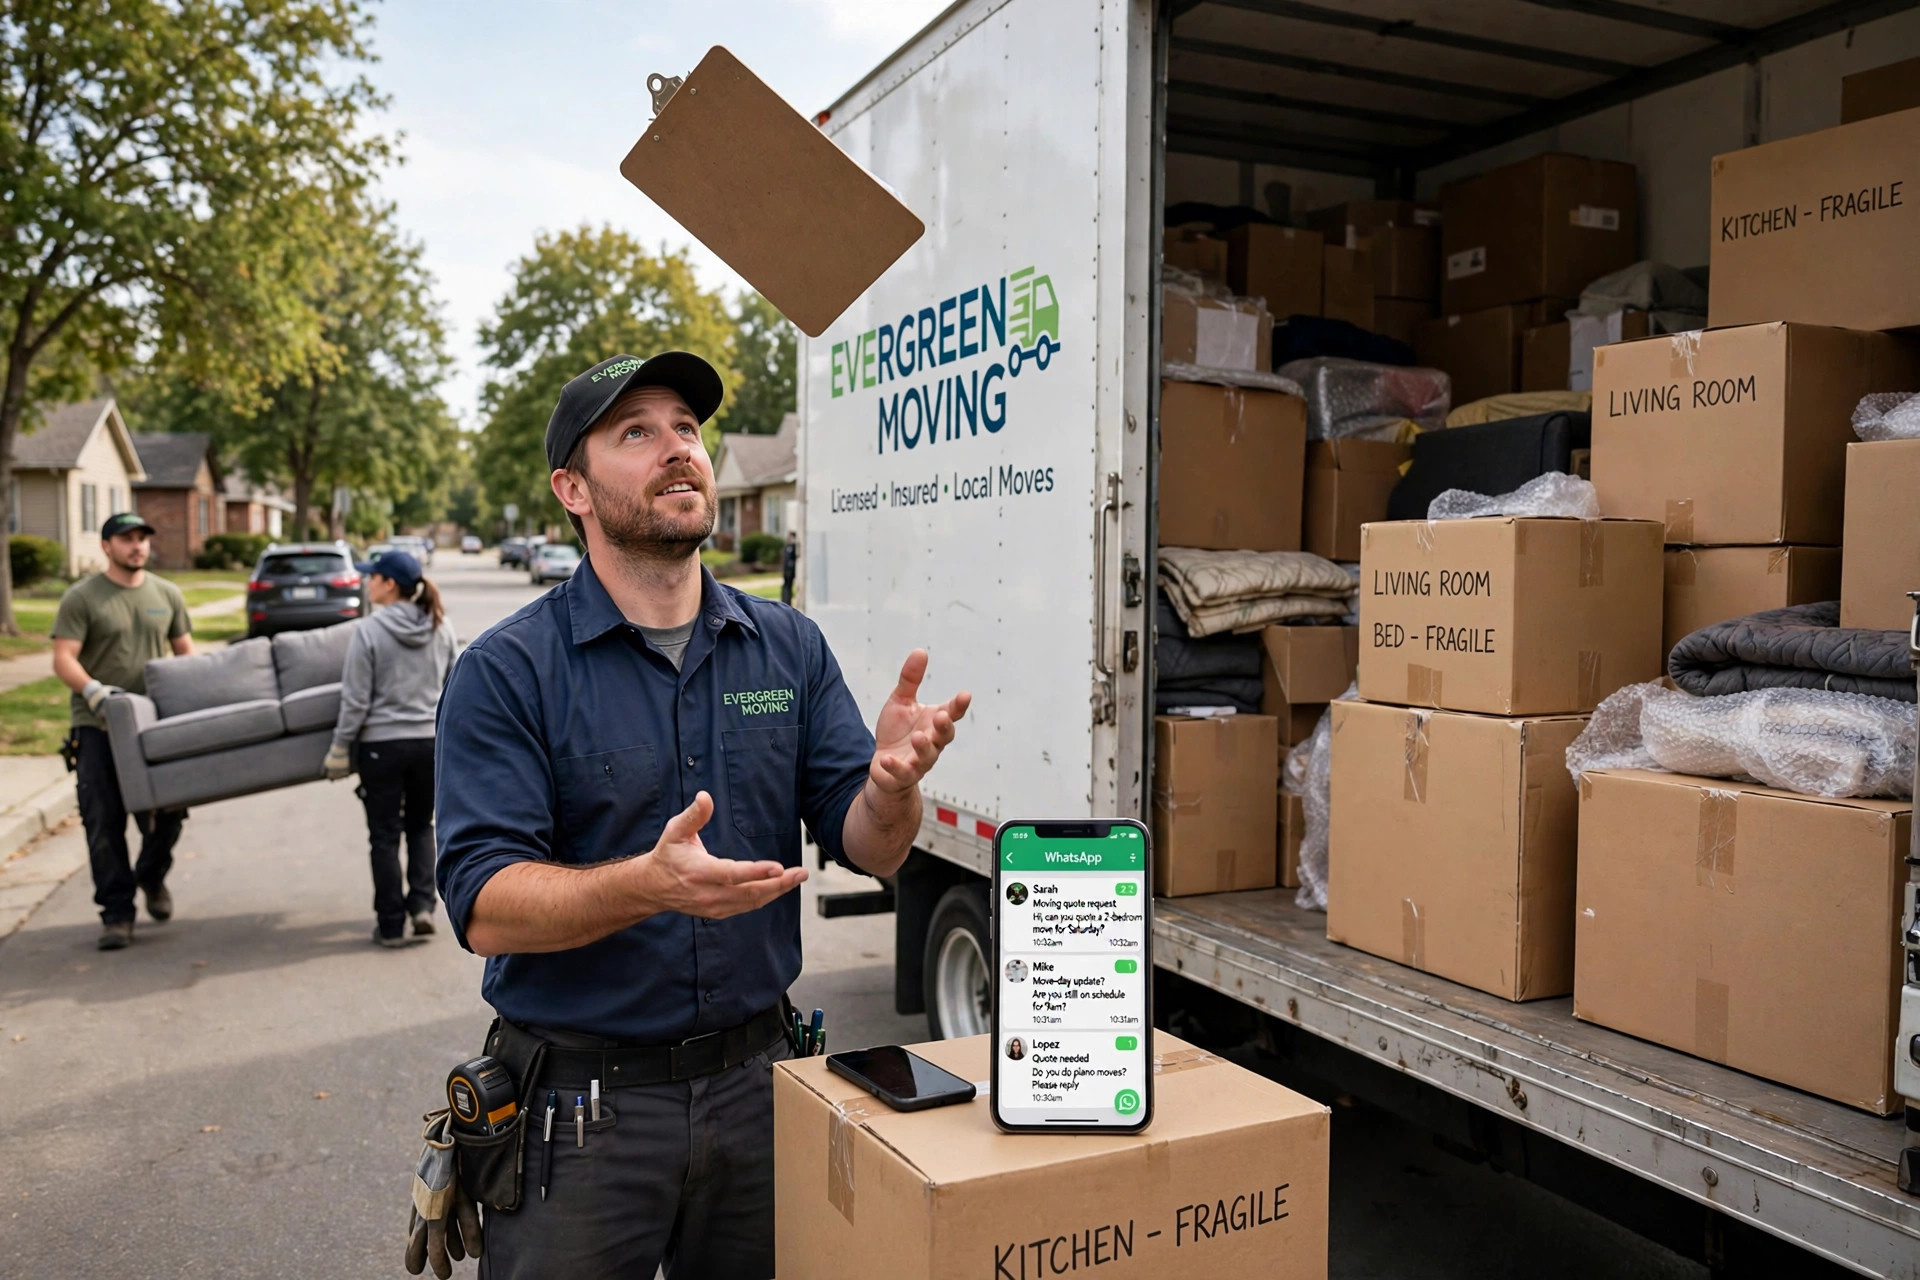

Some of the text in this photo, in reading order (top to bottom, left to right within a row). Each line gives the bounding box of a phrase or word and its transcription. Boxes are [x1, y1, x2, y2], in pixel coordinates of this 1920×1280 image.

[1722, 204, 1797, 242] KITCHEN
[1820, 181, 1904, 222] FRAGILE
[831, 276, 1006, 399] EVERGREEN
[1610, 375, 1756, 417] LIVING ROOM
[878, 363, 1006, 455] MOVING
[832, 482, 878, 513] Licensed
[891, 473, 938, 508] Insured
[954, 466, 992, 500] Local
[999, 464, 1054, 496] Moves
[1374, 569, 1490, 597] LIVING ROOM
[1374, 622, 1405, 648] BED
[1426, 625, 1495, 653] FRAGILE
[723, 689, 794, 705] EVERGREEN
[741, 702, 789, 716] MOVING
[1044, 851, 1102, 866] WhatsApp
[1033, 884, 1058, 894] Sarah
[1033, 899, 1117, 910] Moving quote request
[1060, 914, 1073, 923] you
[1033, 925, 1053, 933] move
[1055, 924, 1065, 934] for
[1033, 938, 1063, 947] 10:32am
[1109, 939, 1139, 947] 10:32am
[1033, 962, 1054, 971] Mike
[1032, 976, 1105, 988] Move-day update?
[1032, 990, 1046, 999] Are
[1048, 991, 1062, 1001] you
[1092, 989, 1126, 999] schedule
[1032, 1001, 1043, 1011] for
[1033, 1015, 1062, 1023] 10:31am
[1109, 1015, 1139, 1023] 10:31am
[1033, 1039, 1060, 1051] Lopez
[1032, 1053, 1089, 1063] Quote needed
[1032, 1067, 1127, 1079] Do you do piano moves?
[1032, 1080, 1079, 1091] Please reply
[1033, 1094, 1063, 1102] 10:30am
[995, 1219, 1134, 1280] KITCHEN
[1176, 1183, 1290, 1247] FRAGILE
